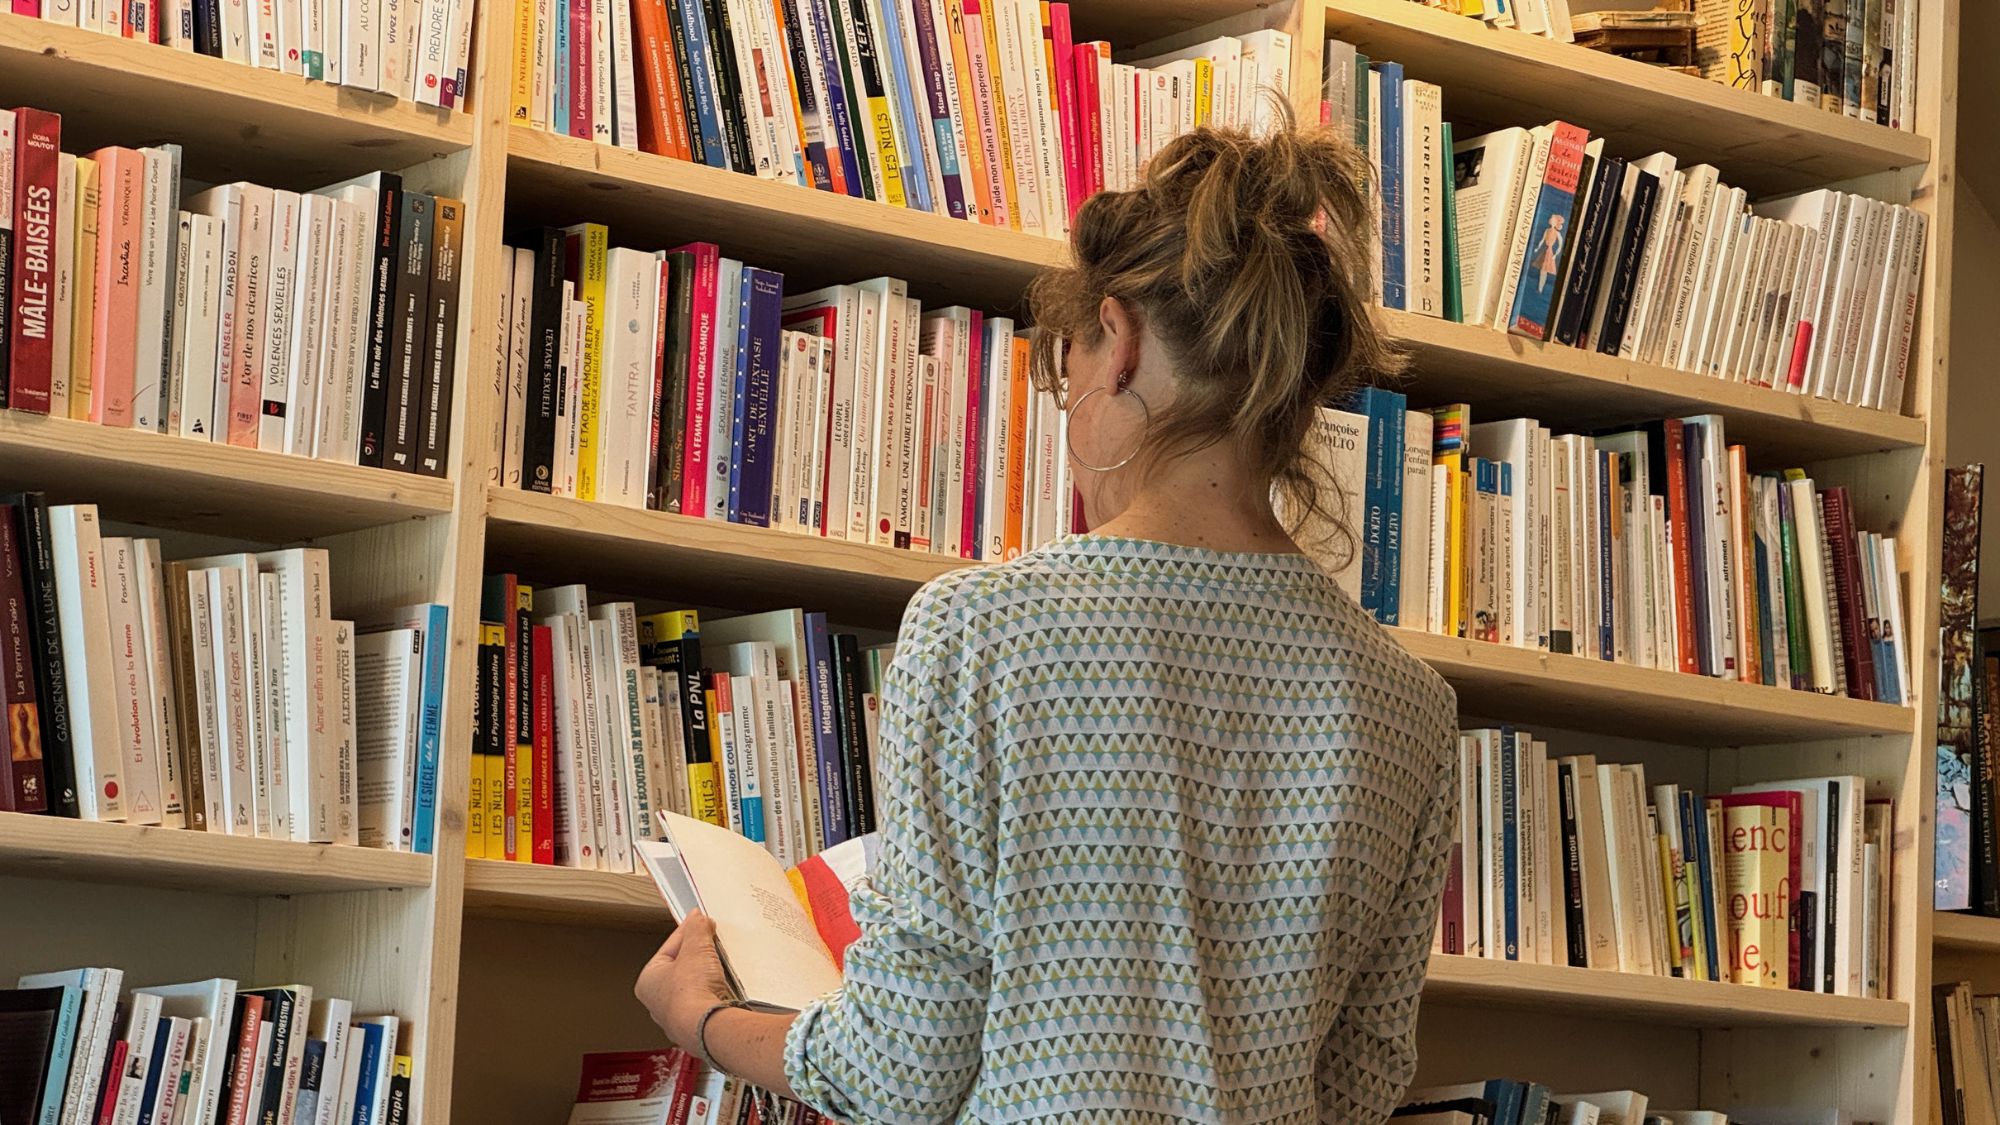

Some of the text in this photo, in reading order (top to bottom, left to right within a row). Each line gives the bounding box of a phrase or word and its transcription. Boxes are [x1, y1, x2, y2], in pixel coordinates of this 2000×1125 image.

[388, 16, 397, 43] vivez
[428, 9, 444, 62] PRENDRE
[854, 18, 870, 57] L'EFT
[456, 69, 464, 95] POCKET
[932, 71, 946, 114] Mind map
[946, 61, 958, 95] VITESSE
[975, 54, 989, 98] apprendre
[951, 98, 962, 127] TOUTE
[981, 101, 993, 125] mieux
[27, 139, 55, 151] MOUTOT
[877, 112, 899, 179] LES NULS
[957, 138, 966, 157] LIRE
[985, 135, 997, 162] enfant
[1537, 140, 1550, 177] LENOIR
[123, 168, 132, 176] M.
[988, 165, 1000, 183] mon
[991, 186, 1003, 209] J'aide
[19, 184, 51, 339] MÂLE-BAISÉES
[226, 250, 237, 297] PARDON
[245, 254, 259, 315] cicatrices
[244, 318, 256, 340] nos
[269, 267, 286, 385] VIOLENCES SEXUELLES
[370, 257, 388, 389] Le livre noir des violences sexuelles
[1897, 292, 1916, 380] MOURIR DE DIRE
[243, 343, 255, 359] de
[542, 328, 554, 417] L'EXTASE SEXUELLE
[582, 352, 592, 397] L'AMOUR
[626, 361, 640, 418] TANTRA
[694, 313, 709, 461] LA FEMME MULTI-ORGASMIQUE
[718, 348, 729, 433] SEXUALITÉ FÉMININE
[905, 348, 916, 410] PERSONNALITÉ
[580, 414, 590, 435] TAO
[581, 399, 590, 411] DE
[835, 403, 844, 442] LE COUPLE
[905, 412, 913, 423] DE
[579, 437, 589, 448] LE
[672, 430, 684, 481] Slow Sex
[903, 426, 913, 459] AFFAIRE
[997, 417, 1007, 478] L'art d'aimer
[1044, 435, 1052, 500] L'homme idéal
[902, 462, 911, 479] UNE
[1370, 506, 1380, 544] DOLTO
[1389, 512, 1399, 550] DOLTO
[117, 549, 128, 604] Pascal Picq
[1505, 594, 1511, 603] se
[124, 624, 143, 763] Et l'évolution créa la femme
[313, 636, 324, 734] Aimer enfin sa mère
[341, 649, 350, 725] ALEXIEVITCH
[491, 654, 500, 746] La Psychologie positive
[520, 616, 530, 737] Booster sa confiance en soi
[688, 671, 705, 730] La PNL
[818, 660, 831, 734] Métagénéalogie
[229, 651, 245, 772] Aventurières de l'esprit
[425, 704, 439, 736] FEMME
[507, 642, 516, 789] 1001 activités autour du livre
[583, 645, 603, 826] manuel de Communication NonViolente
[741, 706, 755, 777] L'ennéagramme
[421, 798, 433, 808] LE
[492, 780, 502, 836] LES NULS
[521, 777, 531, 833] LES NULS
[702, 780, 715, 817] NULS
[725, 741, 740, 824] LA MÉTHODE COUÉ
[273, 1001, 289, 1066] Richard FORESTIER
[162, 1032, 185, 1107] pour vivre
[234, 1047, 251, 1103] LES CONTES
